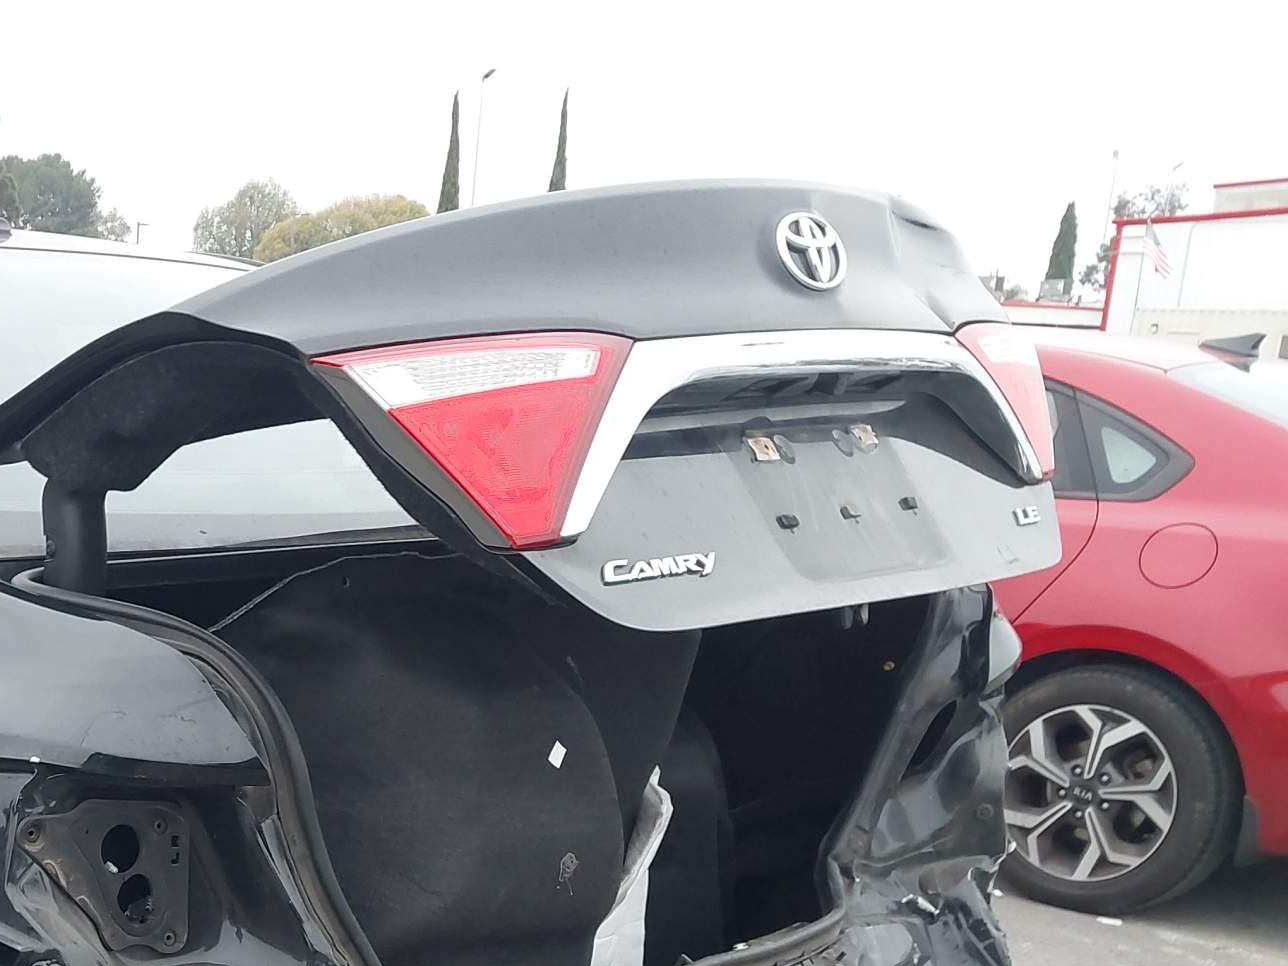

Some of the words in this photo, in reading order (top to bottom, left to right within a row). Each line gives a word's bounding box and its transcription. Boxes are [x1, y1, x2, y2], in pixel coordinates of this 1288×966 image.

[1012, 505, 1041, 526] LE
[601, 551, 716, 586] CAMRY
[1073, 786, 1093, 801] KIA
